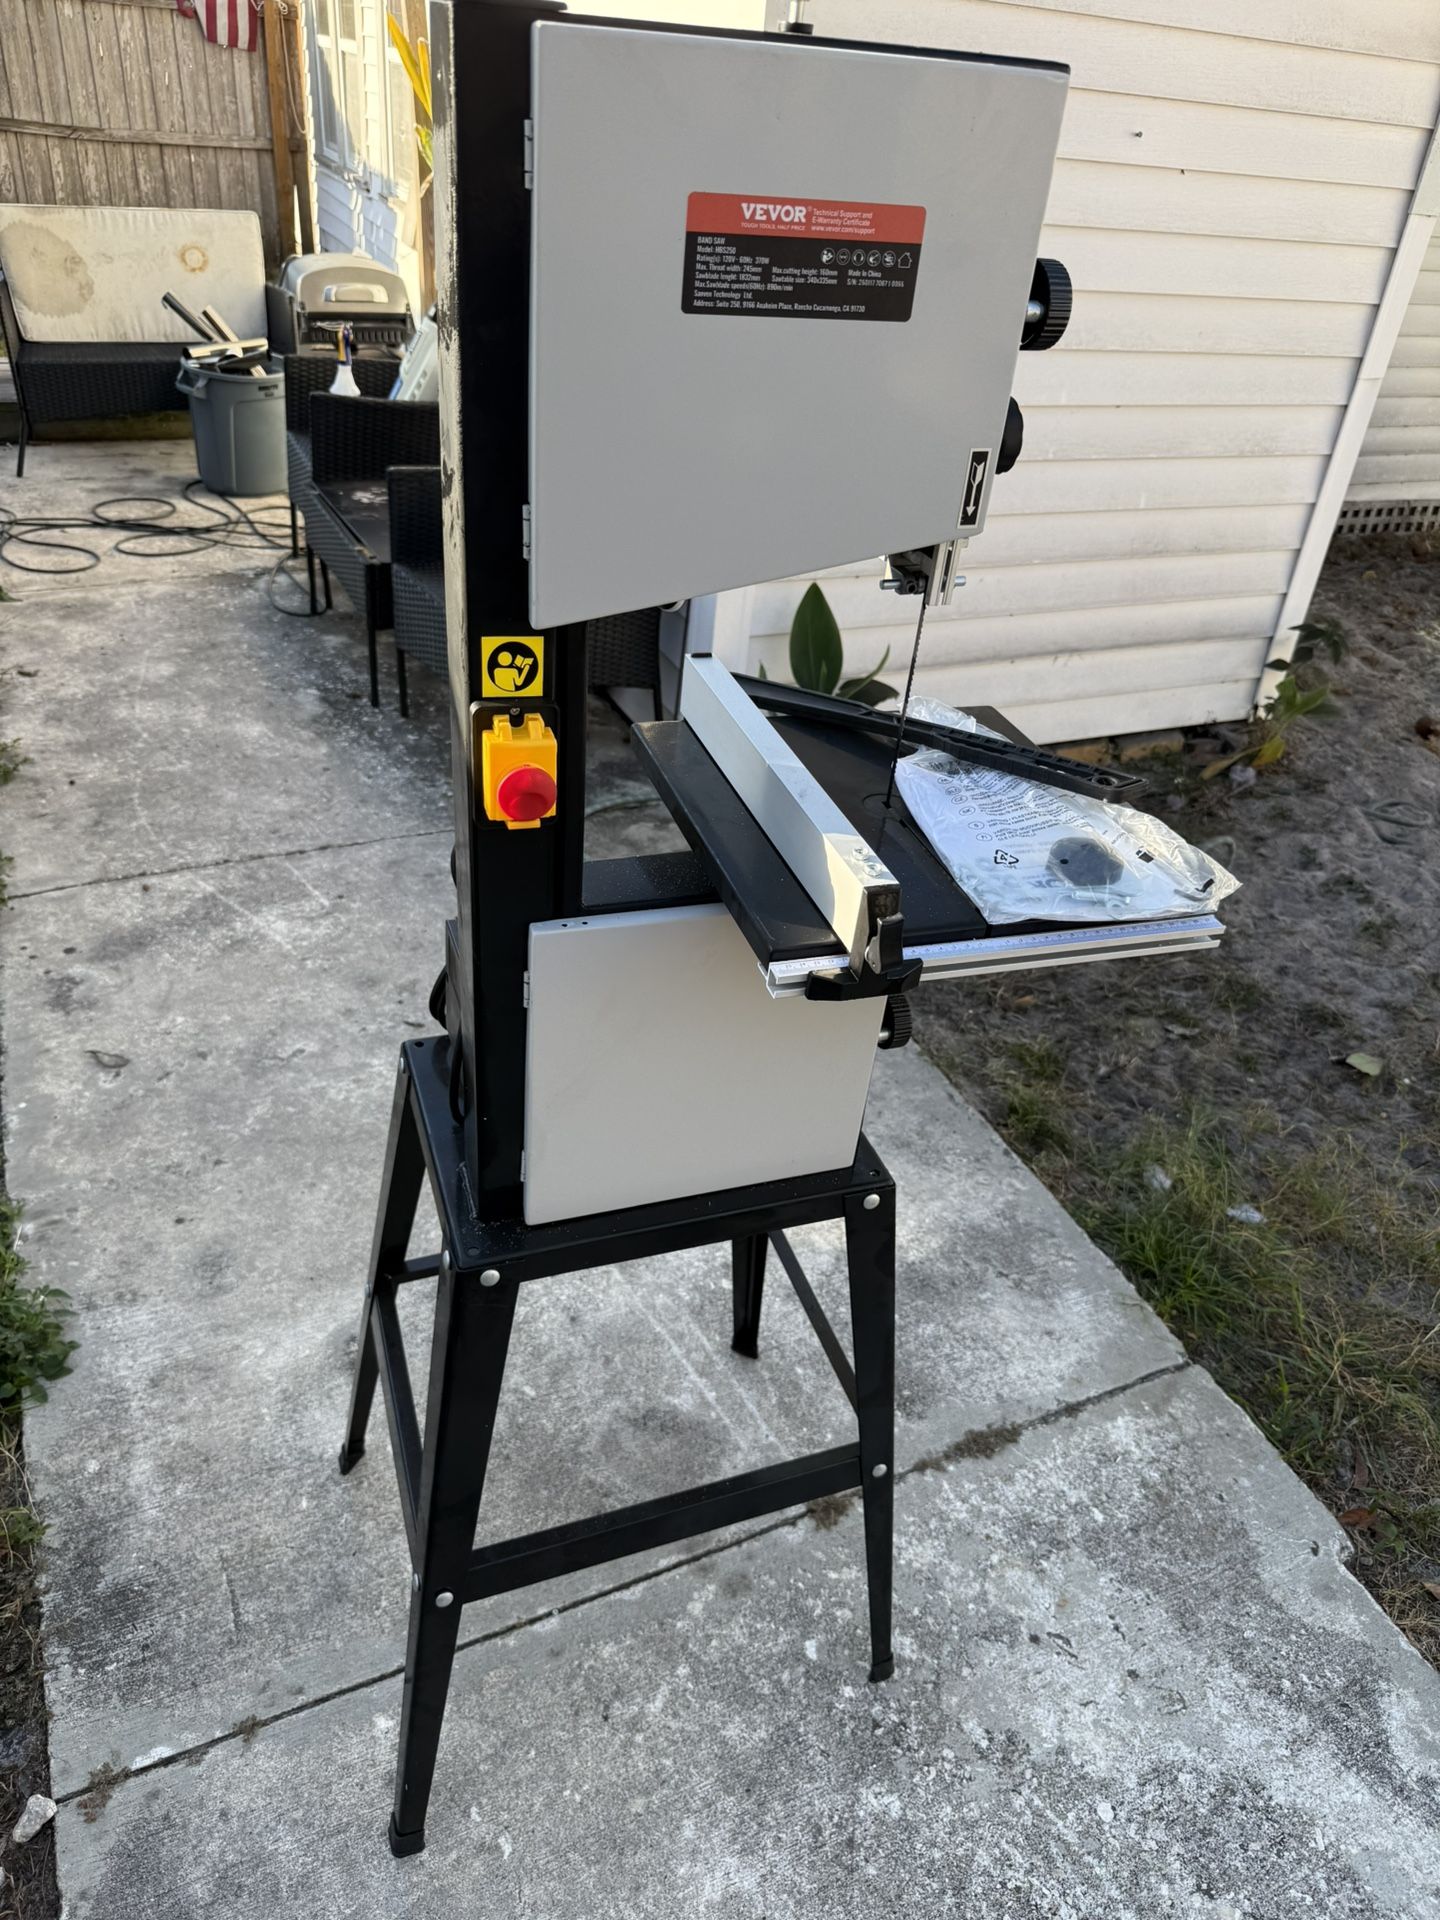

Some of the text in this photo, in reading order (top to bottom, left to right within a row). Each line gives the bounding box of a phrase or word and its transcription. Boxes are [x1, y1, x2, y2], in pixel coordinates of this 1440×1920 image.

[741, 203, 807, 223] VEVOR
[813, 208, 839, 217] Technical
[840, 210, 861, 219] Support
[812, 216, 871, 226] E-Warranty Certificate
[811, 225, 876, 235] www.vevor.com/support
[697, 236, 726, 245] BAND SAW
[697, 245, 714, 254] Model:
[755, 256, 770, 264] 370W
[709, 263, 726, 271] Throat
[696, 271, 720, 280] Sawblade
[802, 268, 818, 277] height:
[772, 275, 795, 283] Sawtable
[694, 290, 712, 298] Sanven
[713, 290, 741, 299] Technology
[693, 299, 715, 307] Address:
[794, 303, 812, 311] Rancho
